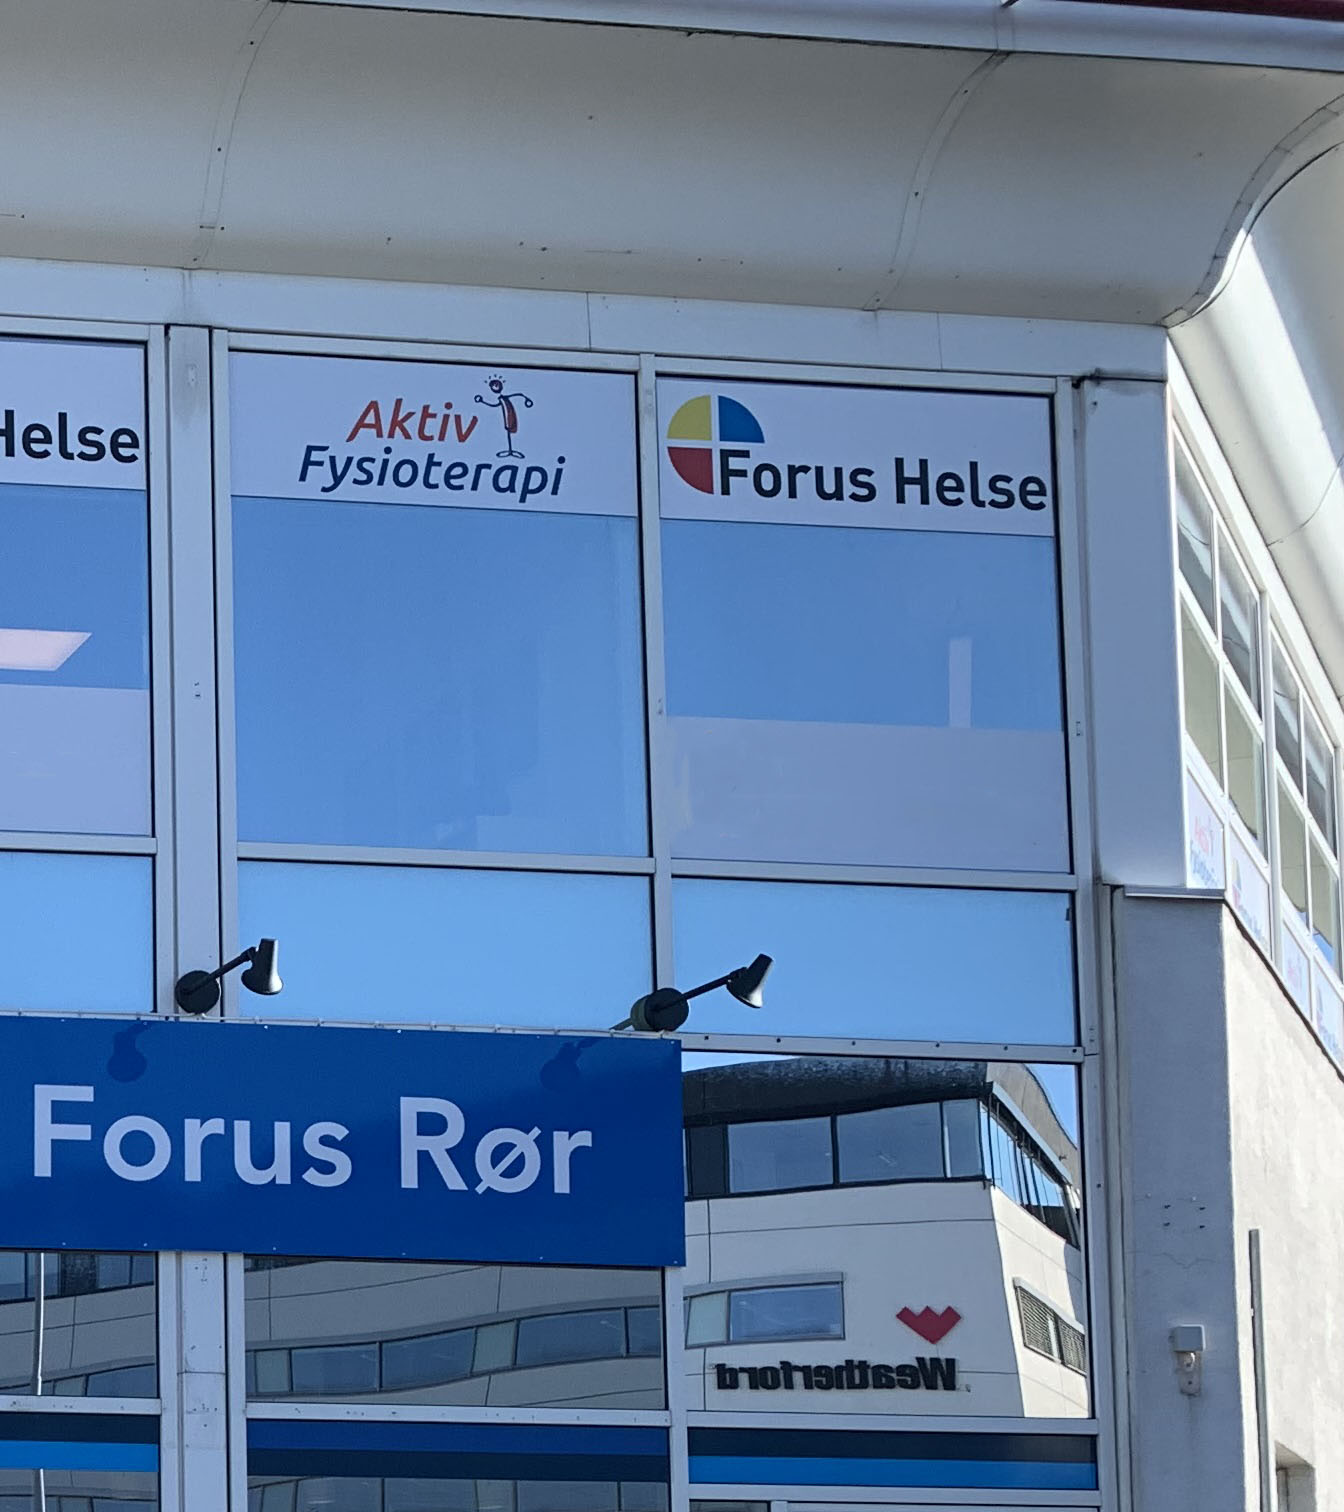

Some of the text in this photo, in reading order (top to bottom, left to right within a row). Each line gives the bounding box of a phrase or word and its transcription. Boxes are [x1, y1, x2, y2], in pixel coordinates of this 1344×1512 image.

[346, 398, 479, 444] Aktiv
[298, 445, 567, 504] Fysioterapi
[719, 449, 1048, 511] Forus Helse
[32, 1083, 593, 1195] Forus Rør
